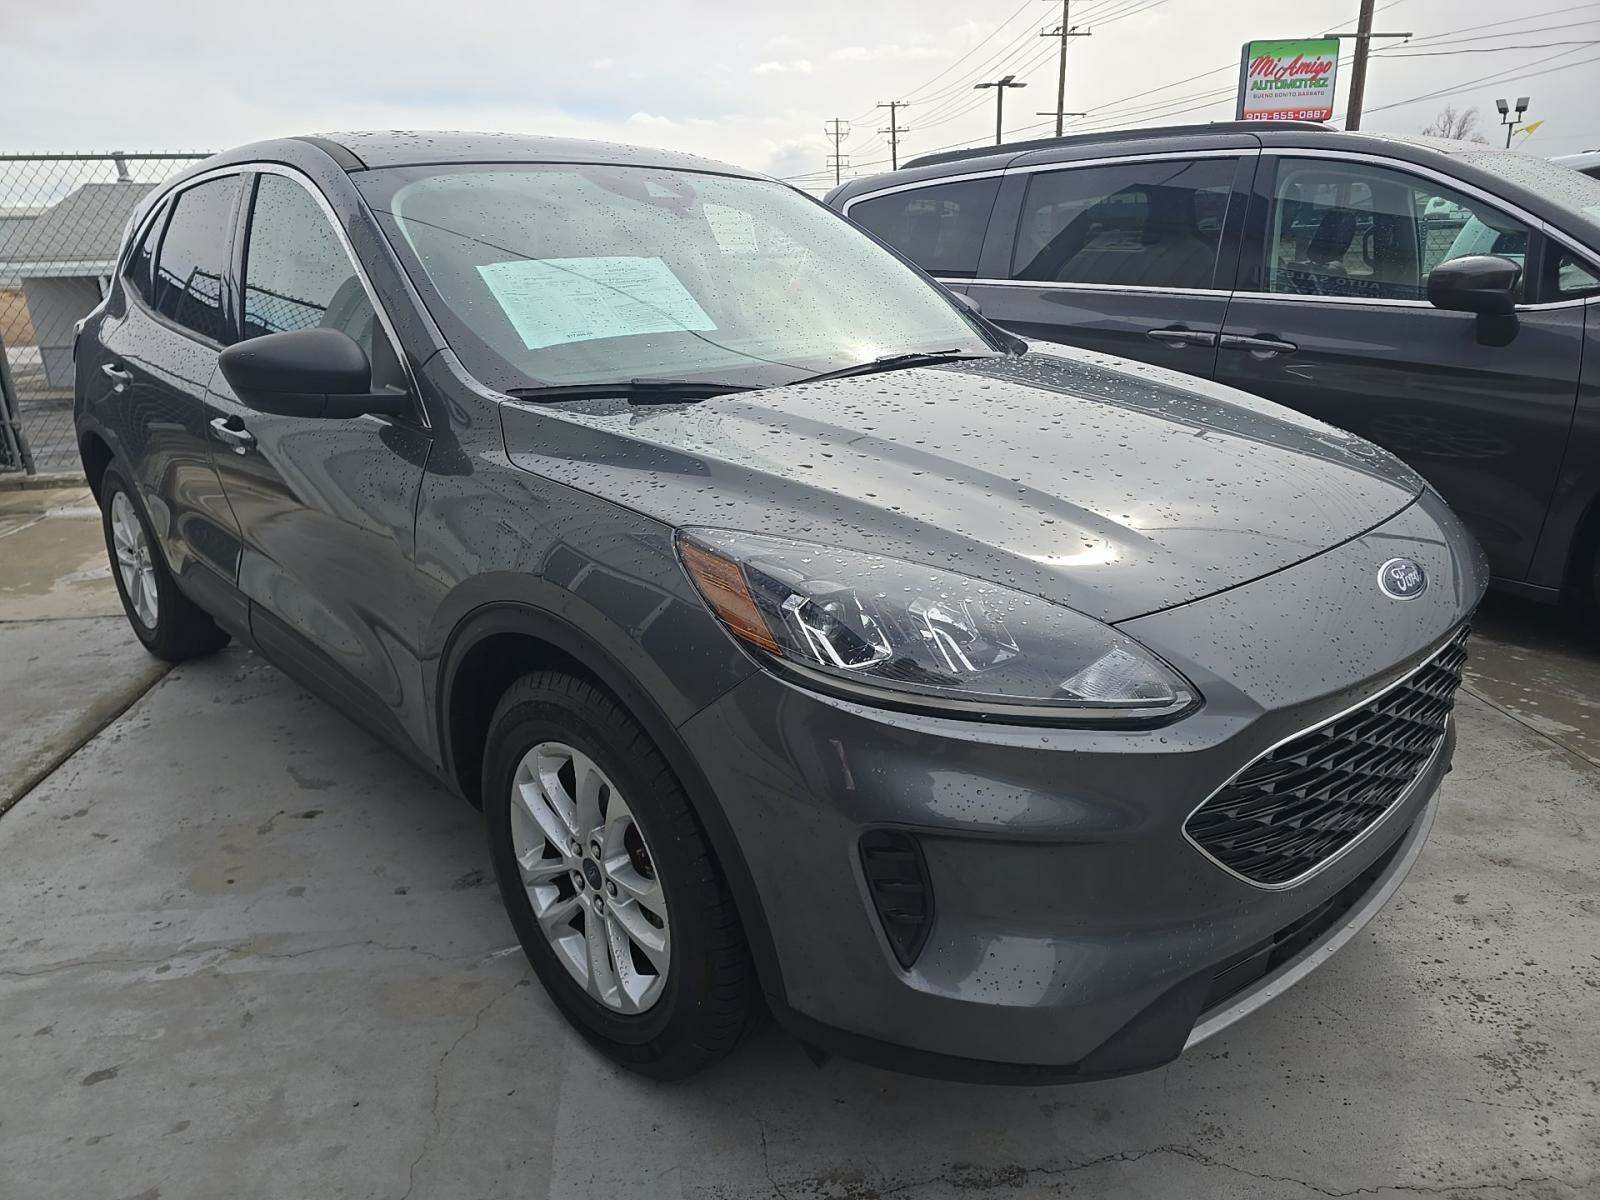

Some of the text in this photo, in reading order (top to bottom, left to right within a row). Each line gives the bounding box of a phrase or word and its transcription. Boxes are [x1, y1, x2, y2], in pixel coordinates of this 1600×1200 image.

[1249, 53, 1332, 81] Mi Amigo
[1251, 77, 1329, 91] AUTOMOTRIZ
[1390, 564, 1420, 592] Ford
